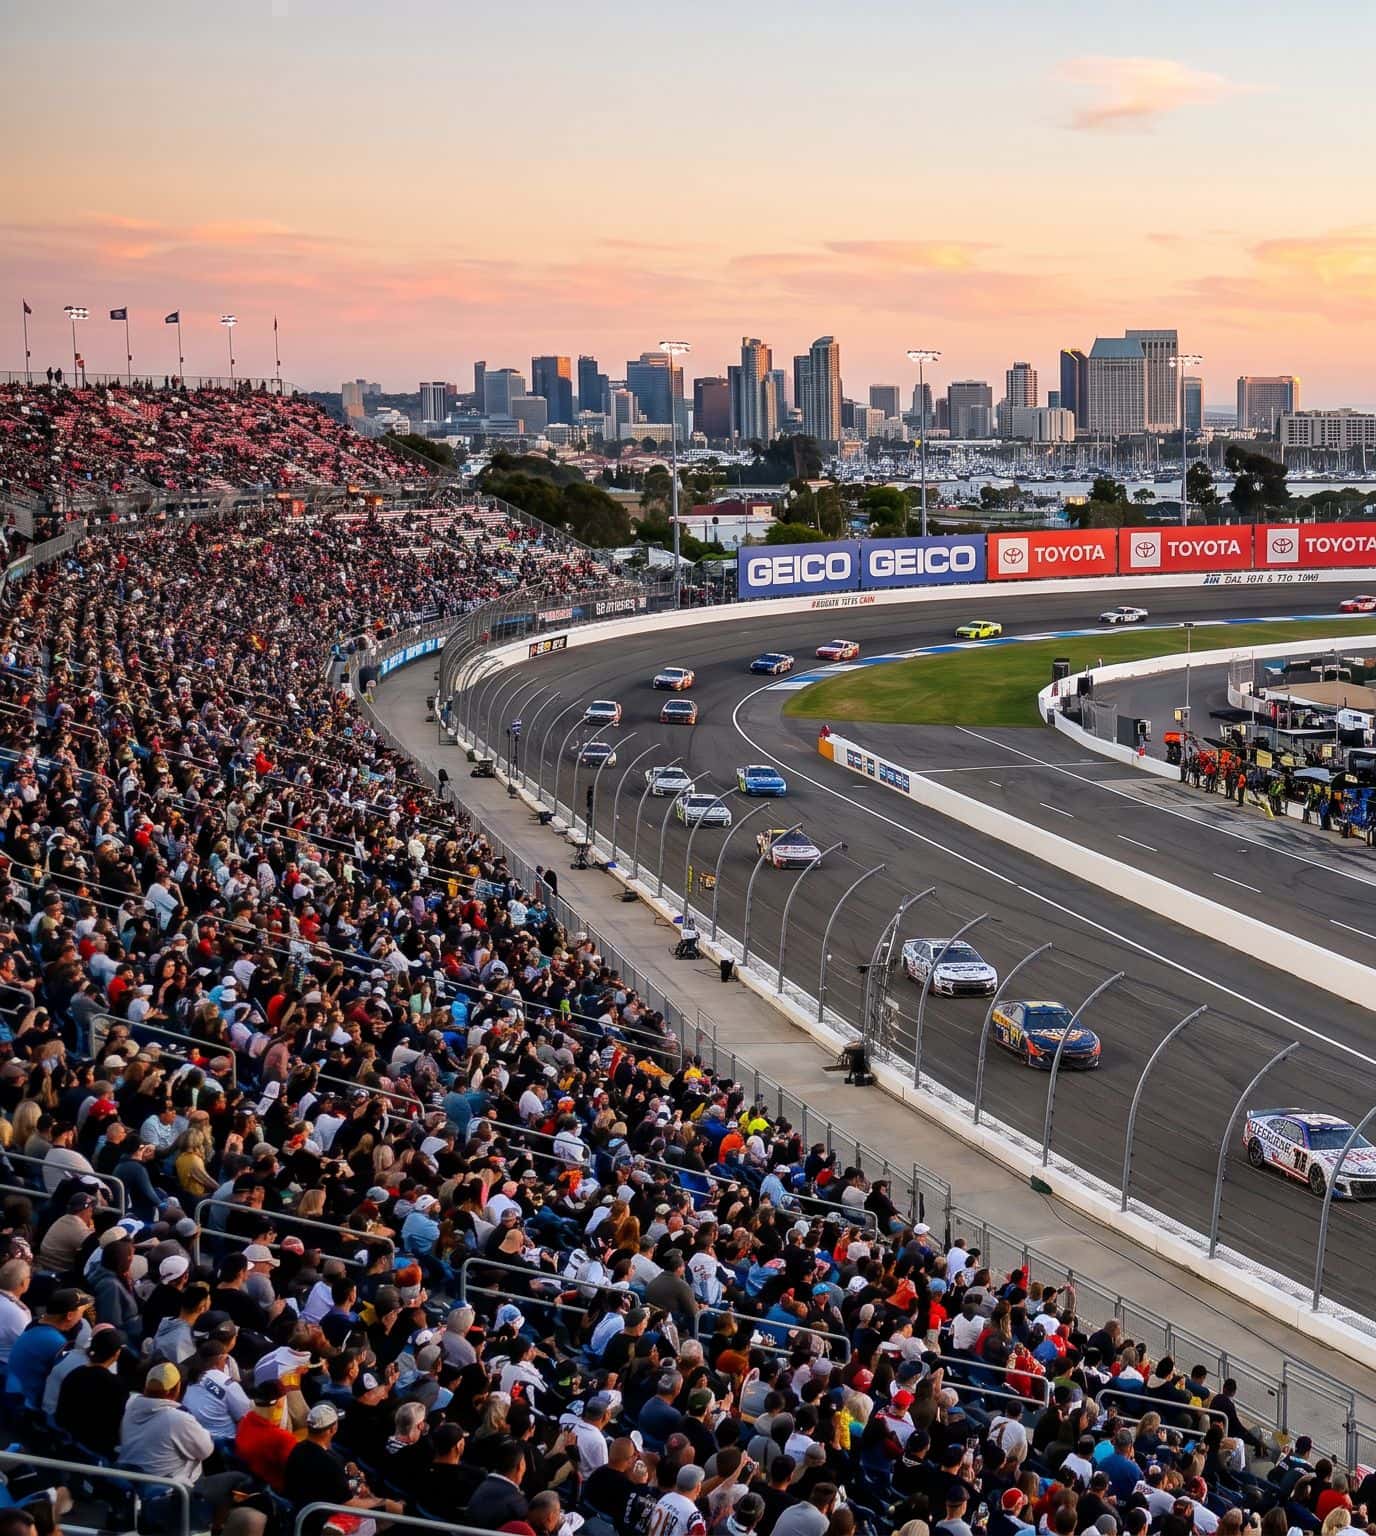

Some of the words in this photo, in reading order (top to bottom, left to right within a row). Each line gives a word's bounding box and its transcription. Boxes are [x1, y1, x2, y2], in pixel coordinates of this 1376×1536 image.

[1034, 544, 1105, 563] TOYOTA
[1168, 539, 1241, 557] TOYOTA
[748, 552, 851, 587] GEICO
[869, 545, 976, 577] GEICO
